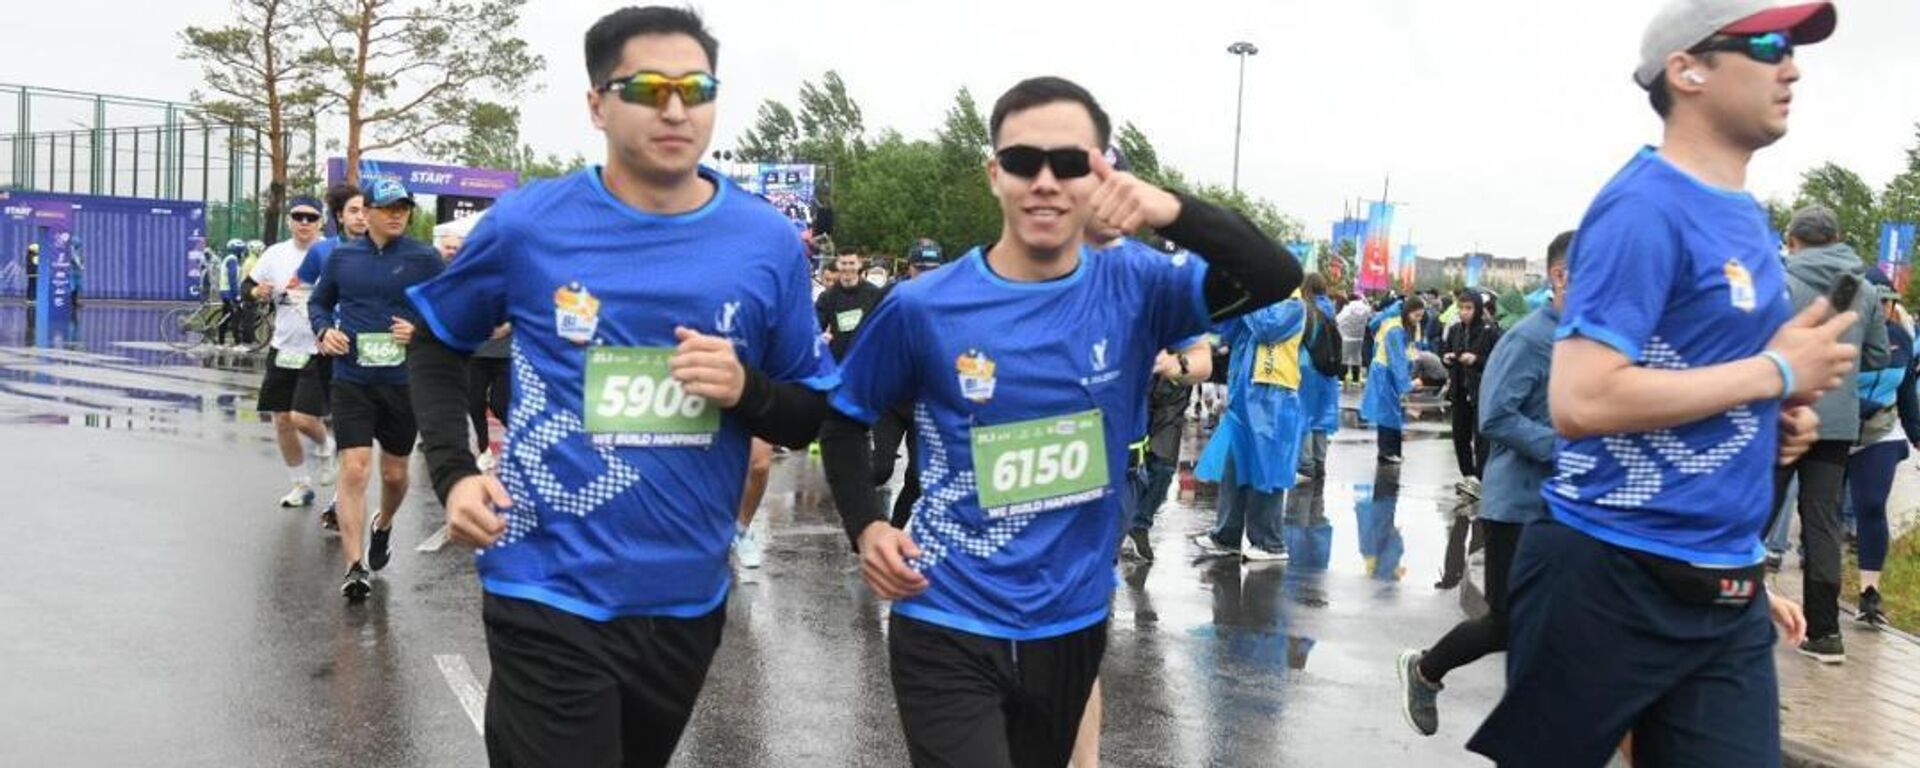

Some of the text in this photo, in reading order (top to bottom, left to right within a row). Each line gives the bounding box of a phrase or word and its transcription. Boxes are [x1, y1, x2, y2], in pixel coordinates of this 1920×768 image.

[410, 171, 452, 186] START
[615, 433, 651, 446] BUILD
[653, 433, 712, 446] HAPPINESS
[992, 440, 1089, 491] 6150
[1009, 501, 1042, 515] BUILD
[1044, 488, 1104, 509] HAPPINESS
